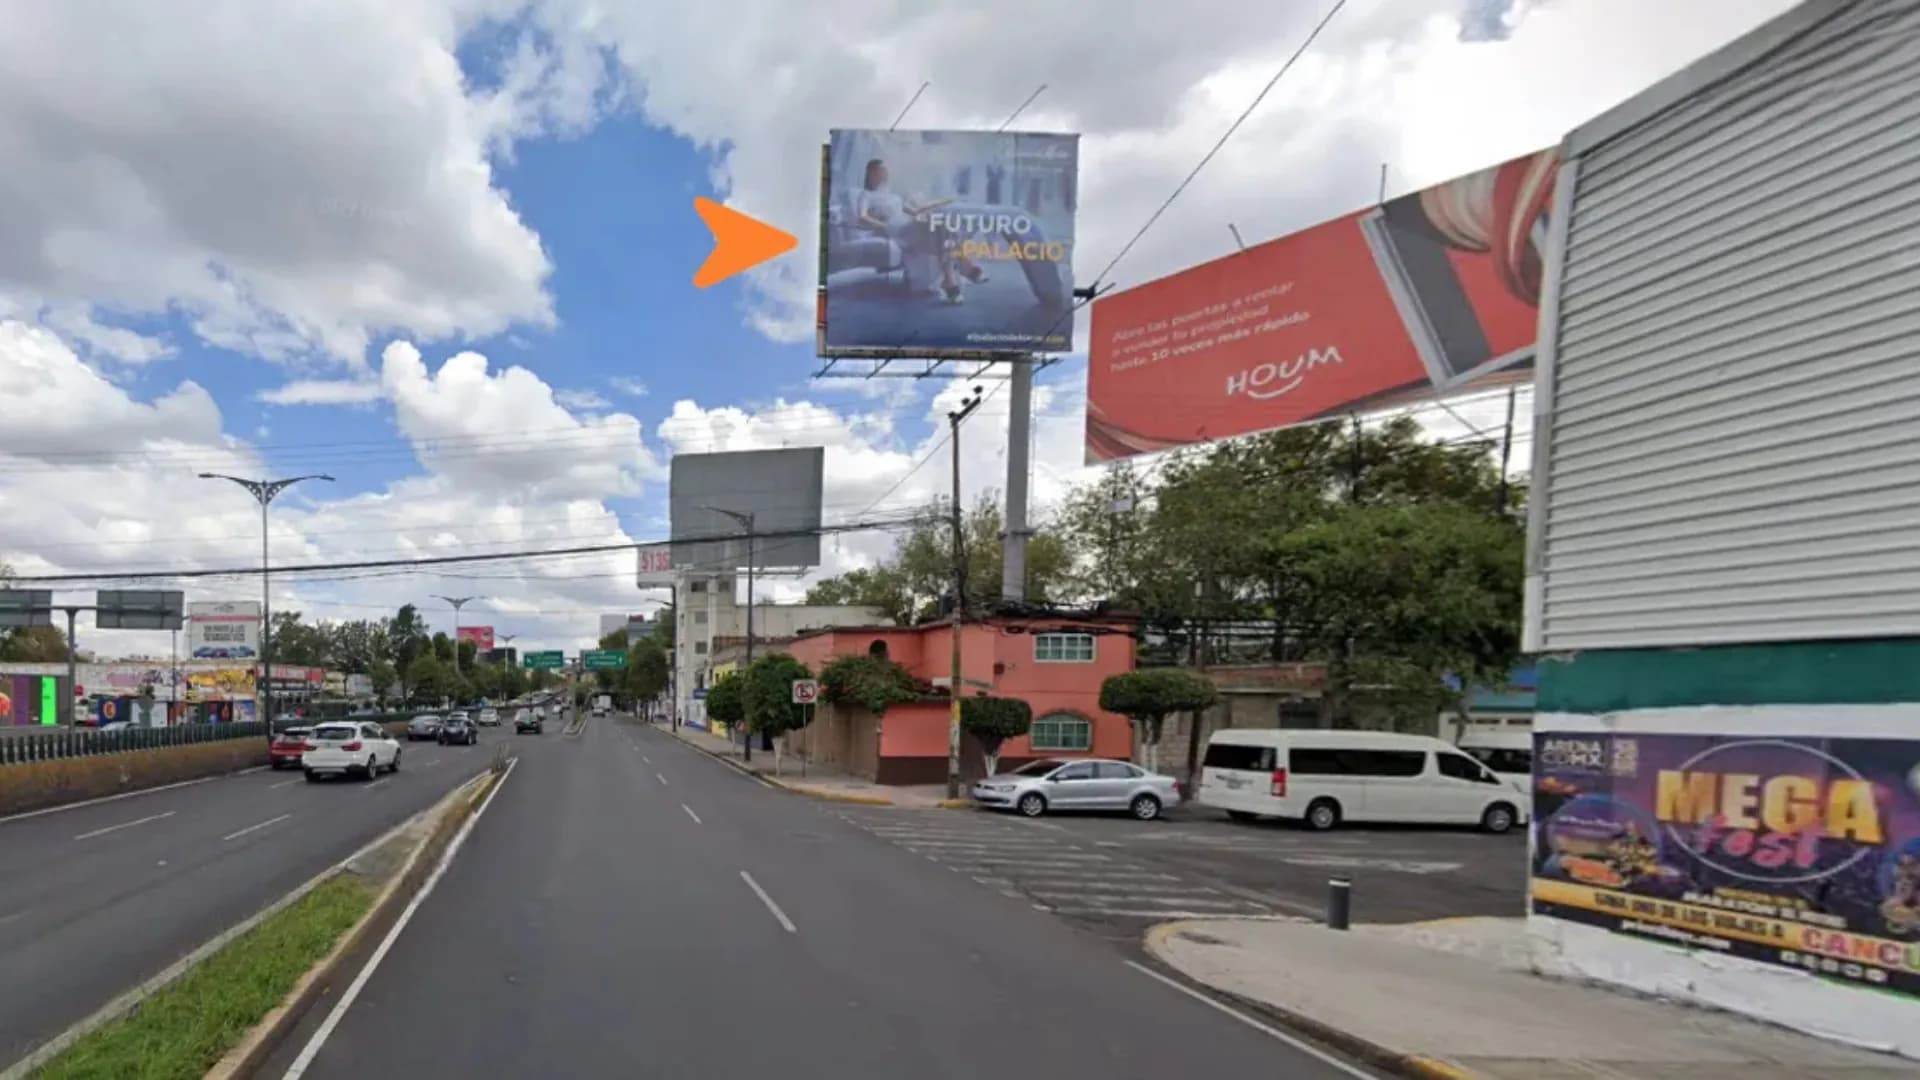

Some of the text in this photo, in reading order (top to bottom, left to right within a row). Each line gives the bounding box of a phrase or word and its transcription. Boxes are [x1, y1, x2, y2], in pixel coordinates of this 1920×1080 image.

[930, 213, 1032, 235] FUTURO
[962, 239, 1066, 262] PALACIO
[1172, 303, 1227, 327] puertas
[1245, 281, 1294, 302] rentar
[1191, 304, 1269, 337] propiedad
[1110, 311, 1310, 374] hasta 10 veces más rápido
[1227, 346, 1343, 396] HOUM
[1541, 752, 1606, 767] CDMX
[1544, 740, 1601, 753] ARENA
[1656, 769, 1883, 845] MEGA
